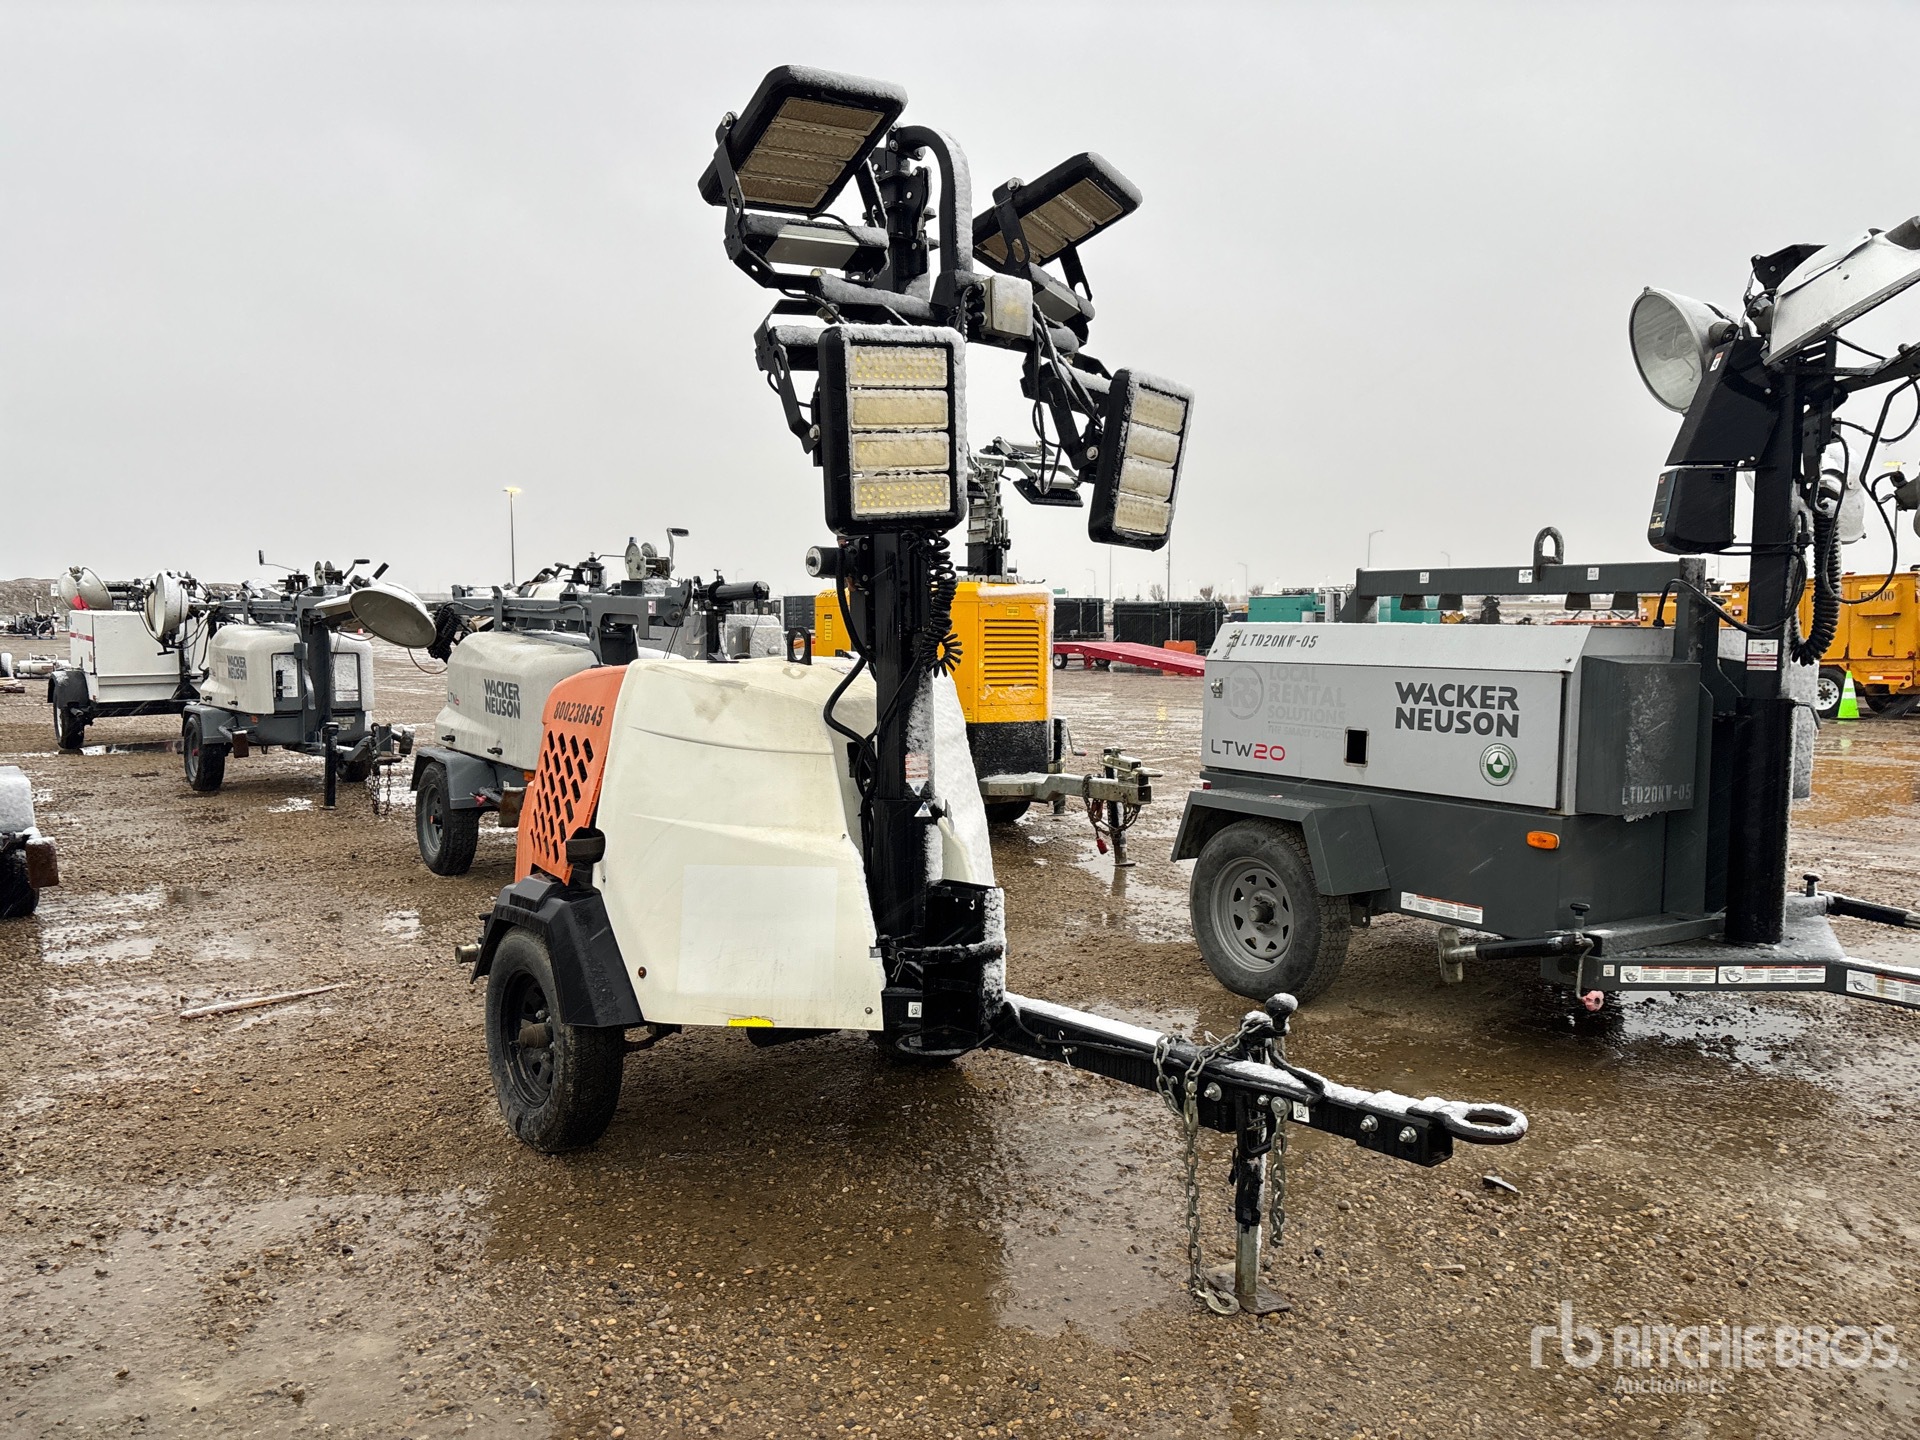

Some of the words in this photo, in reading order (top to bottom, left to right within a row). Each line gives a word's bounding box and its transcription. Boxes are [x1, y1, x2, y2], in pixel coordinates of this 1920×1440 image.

[1269, 665, 1318, 683] LOCAL
[484, 678, 520, 702] WACKER
[1268, 683, 1346, 708] RENTAL
[1394, 681, 1520, 711] WACKER
[485, 696, 520, 720] NEUSON
[553, 700, 606, 727] 800238645
[1394, 706, 1520, 739] NEUSON
[1210, 738, 1286, 761] LTW20
[1621, 783, 1692, 805] LTD20KW-05
